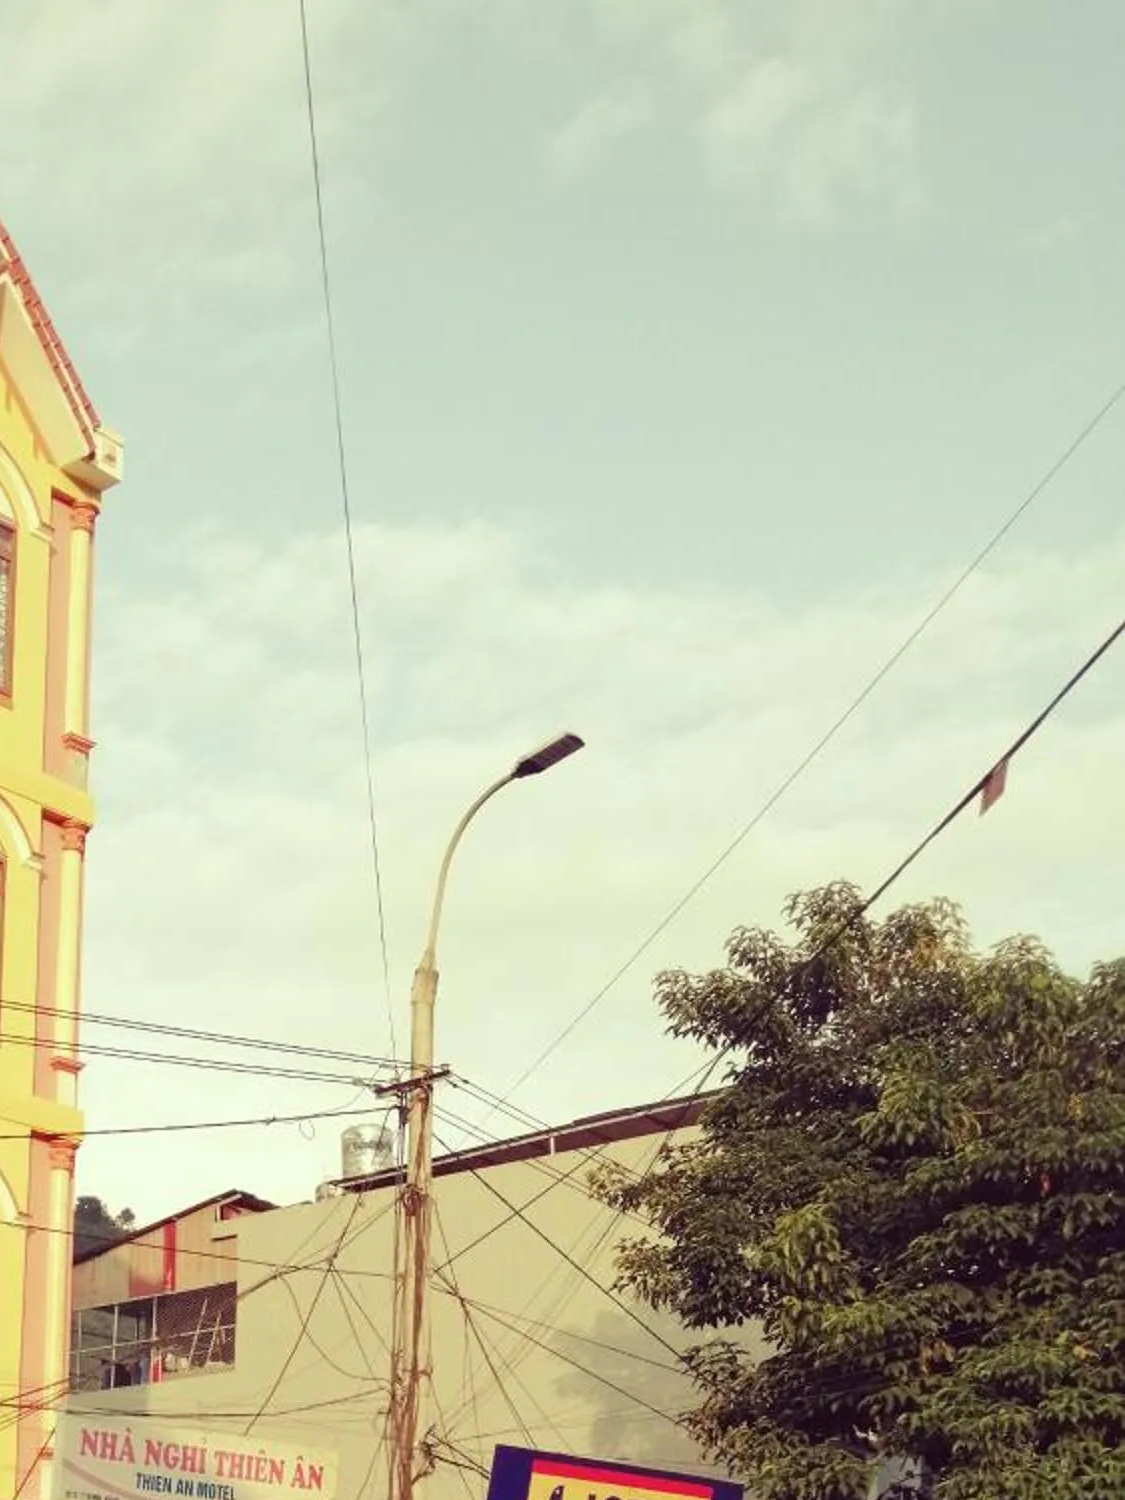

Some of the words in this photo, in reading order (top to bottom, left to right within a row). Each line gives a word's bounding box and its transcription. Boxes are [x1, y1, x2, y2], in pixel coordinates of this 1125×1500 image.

[80, 1428, 135, 1464] NHÀ
[144, 1437, 206, 1474] NGHỈ
[214, 1450, 285, 1484] THIÊN
[291, 1456, 324, 1490] ÂN
[136, 1472, 172, 1493] THIEN
[176, 1478, 194, 1495] AN
